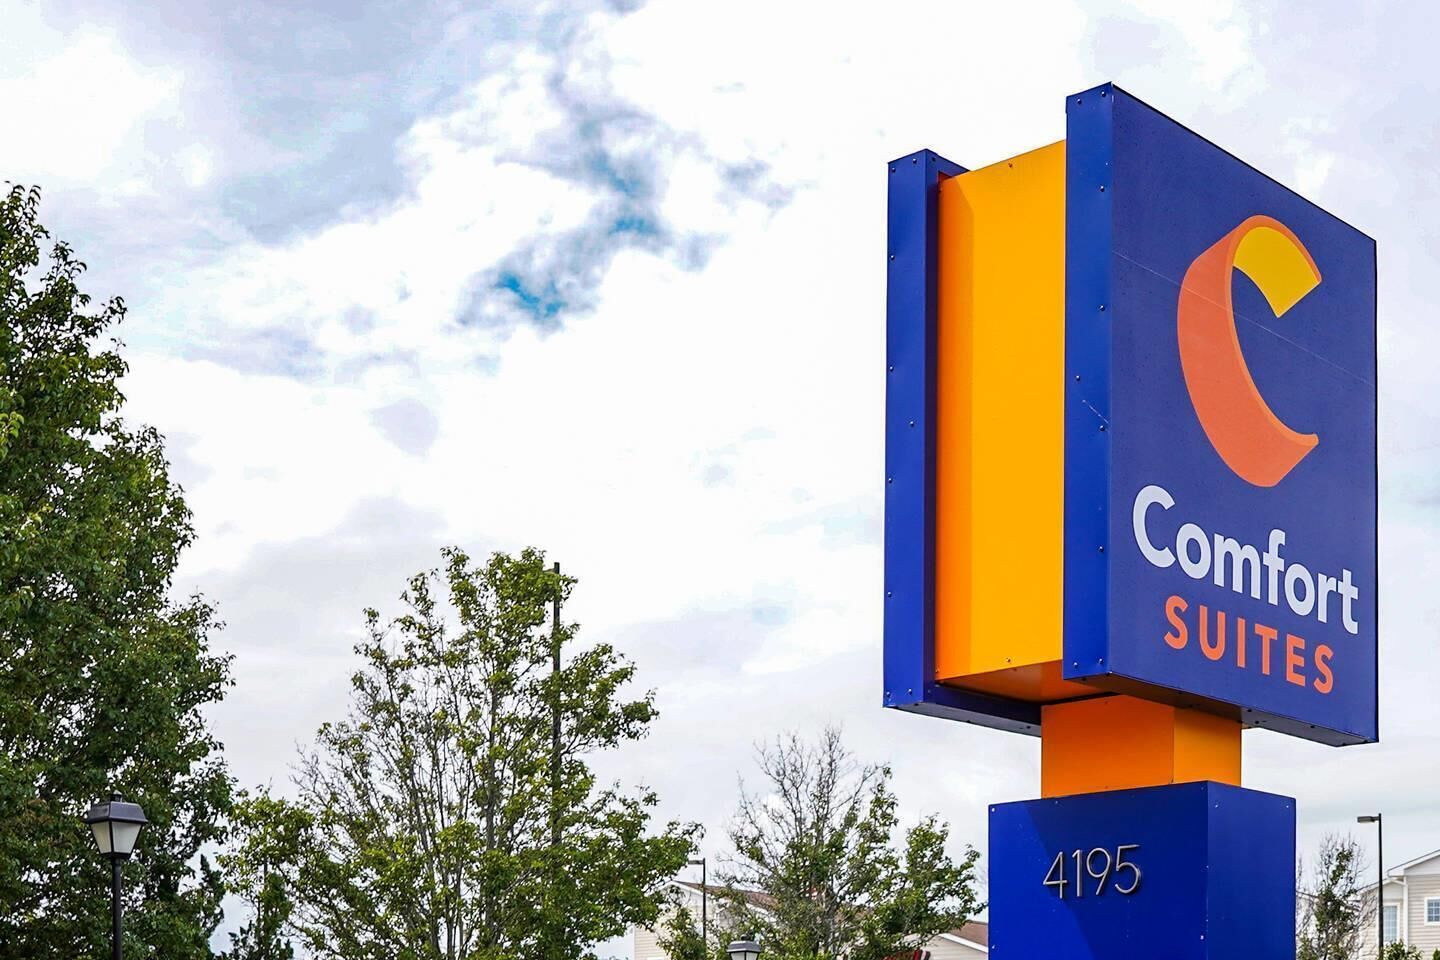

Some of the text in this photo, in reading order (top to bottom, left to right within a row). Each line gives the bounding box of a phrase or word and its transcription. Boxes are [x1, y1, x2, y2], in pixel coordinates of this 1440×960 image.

[1132, 484, 1359, 635] Comfort
[1163, 594, 1334, 695] SUITES
[1042, 843, 1142, 899] 4195
